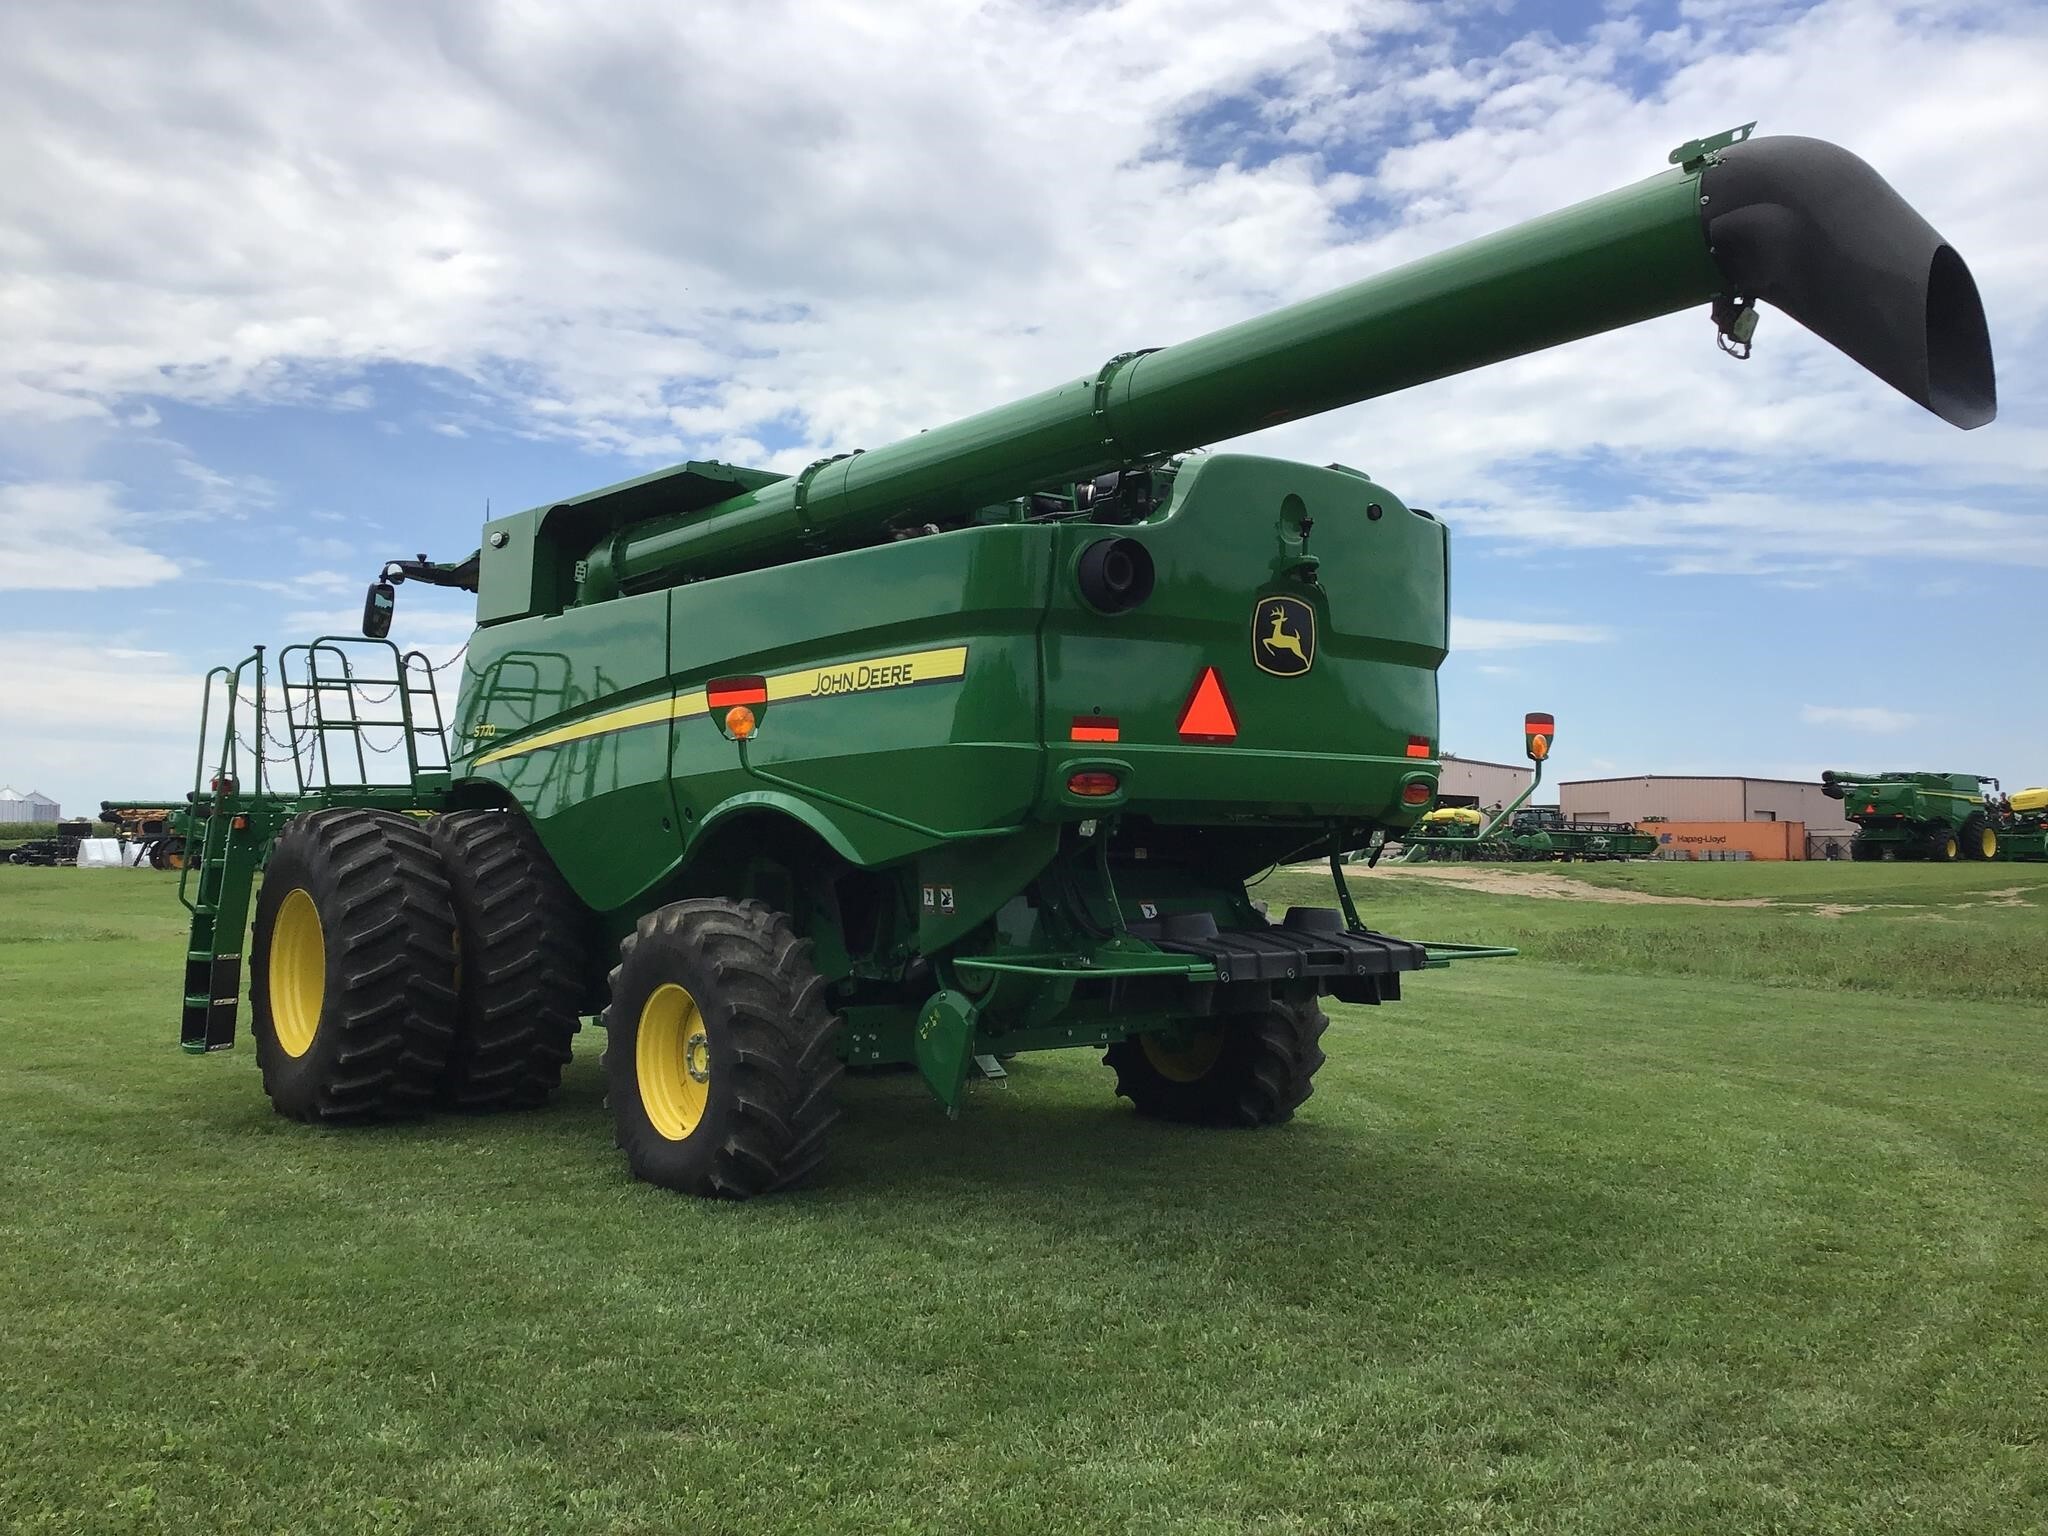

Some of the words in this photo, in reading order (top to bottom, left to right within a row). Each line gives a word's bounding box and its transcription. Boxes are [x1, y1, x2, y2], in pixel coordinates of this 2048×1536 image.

[811, 672, 854, 694] JOHN
[857, 663, 913, 688] DEERE
[473, 724, 496, 738] S770
[1677, 834, 1726, 844] Hapag-Lloyd
